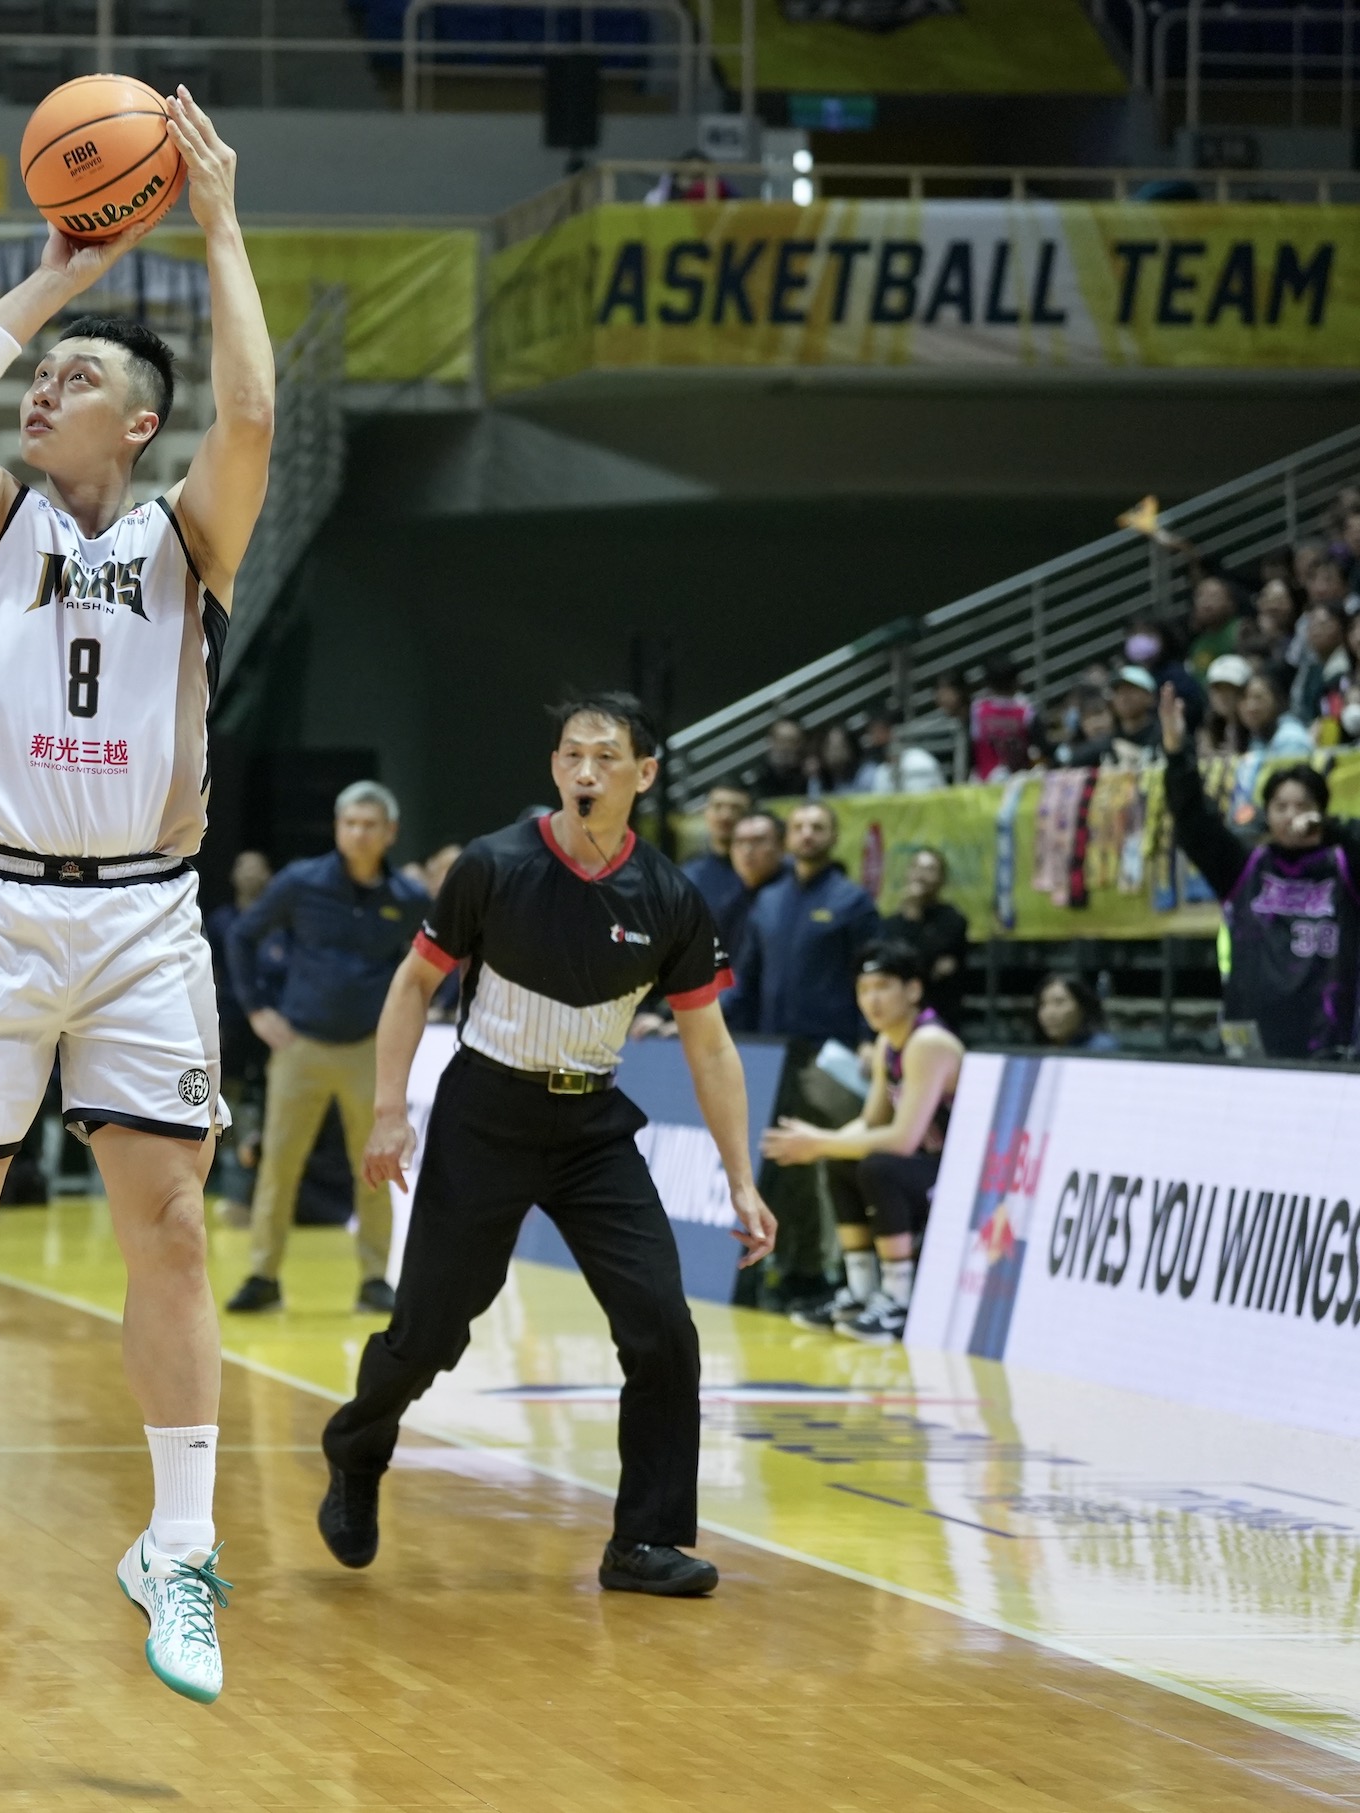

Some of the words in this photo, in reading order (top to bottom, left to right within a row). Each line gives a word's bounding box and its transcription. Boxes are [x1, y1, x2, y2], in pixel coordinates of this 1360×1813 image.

[63, 141, 98, 169] FIBA
[70, 156, 102, 177] APPROVED
[60, 174, 166, 232] Wilson
[586, 238, 1067, 328] ASKETBALL
[1113, 239, 1335, 328] TEAM
[64, 601, 115, 615] AISHIN
[68, 637, 101, 719] 8
[30, 733, 129, 766] 新光三越
[1048, 1168, 1144, 1288] GIVES
[1139, 1177, 1219, 1300] YOU
